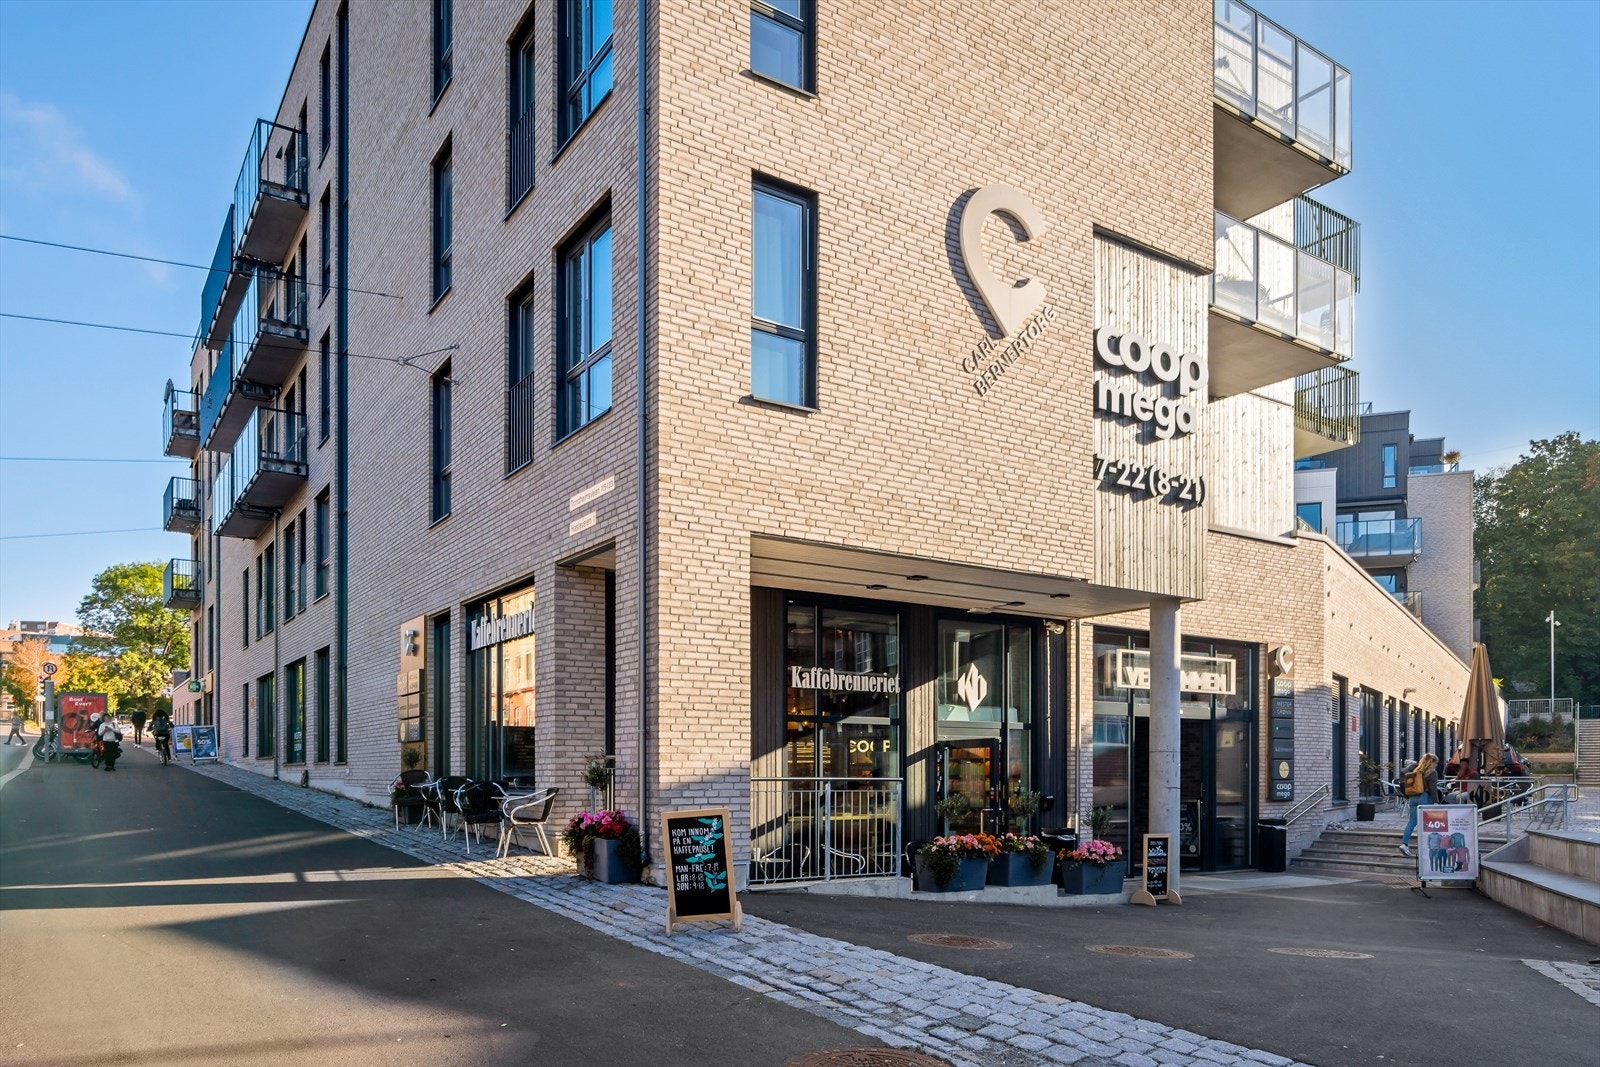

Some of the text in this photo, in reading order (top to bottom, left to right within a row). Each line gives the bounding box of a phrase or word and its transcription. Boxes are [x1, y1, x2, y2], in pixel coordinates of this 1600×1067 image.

[962, 336, 998, 374] CARL
[1096, 325, 1209, 396] coop
[1096, 379, 1197, 440] mega
[791, 666, 900, 693] Kaffebrenneriet
[1123, 666, 1227, 692] VEMMEN
[1276, 680, 1292, 689] coop
[1276, 783, 1292, 791] coop
[672, 827, 710, 837] KOM INNOM
[672, 836, 692, 845] PÅ EN
